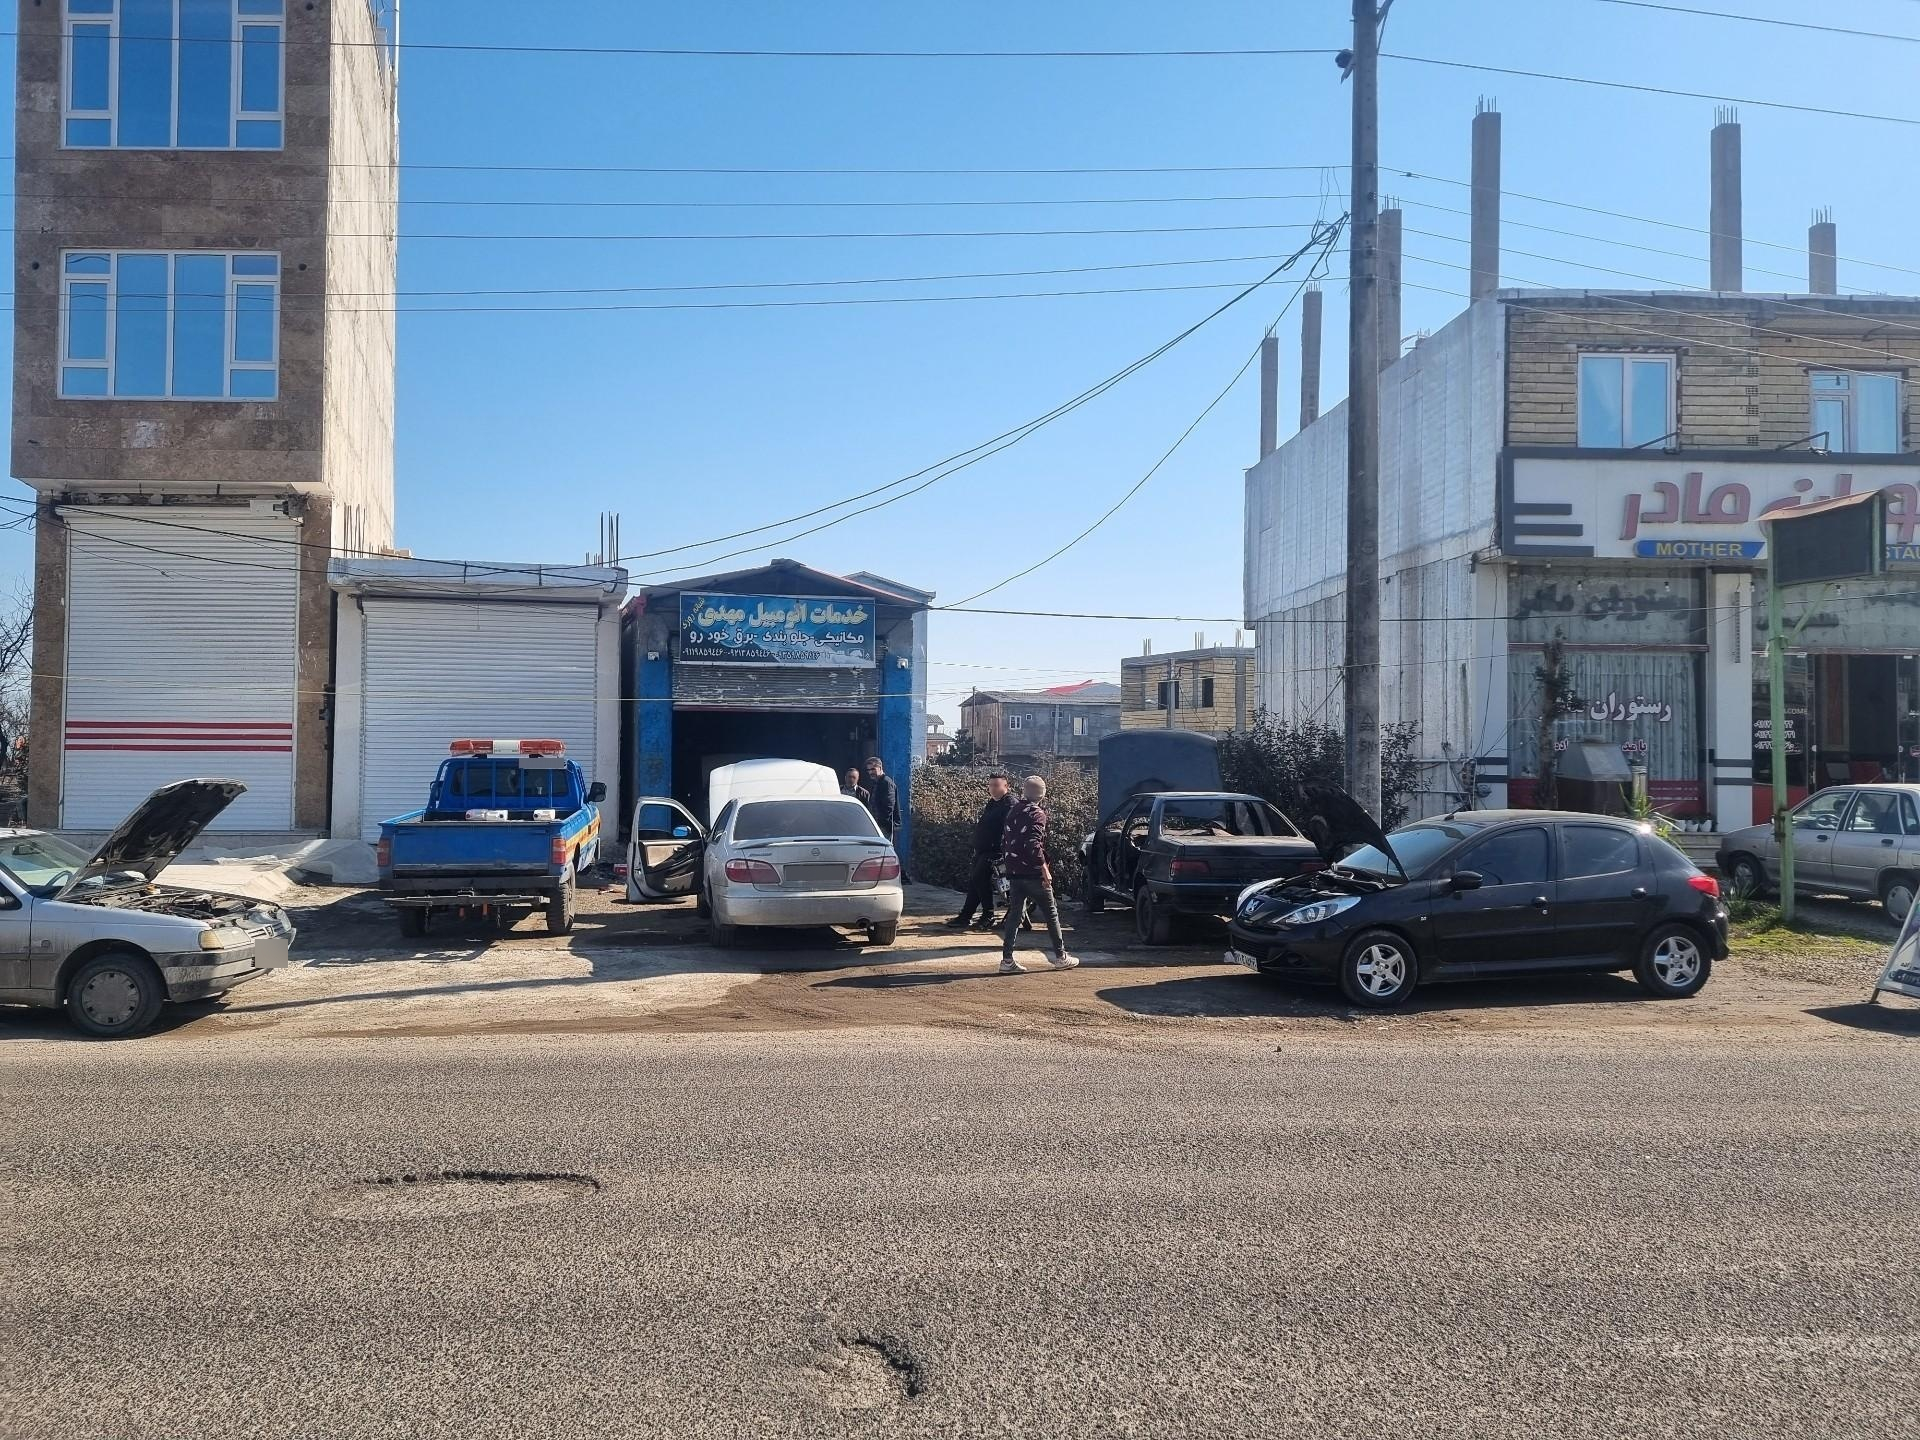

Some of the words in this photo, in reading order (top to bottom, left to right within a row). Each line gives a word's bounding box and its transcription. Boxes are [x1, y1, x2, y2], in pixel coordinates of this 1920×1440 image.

[1619, 471, 1751, 540] مادر
[1656, 542, 1743, 558] MOTHER
[697, 605, 746, 627] مهدی
[810, 604, 868, 625] خدمات
[1590, 692, 1672, 722] رستوران
